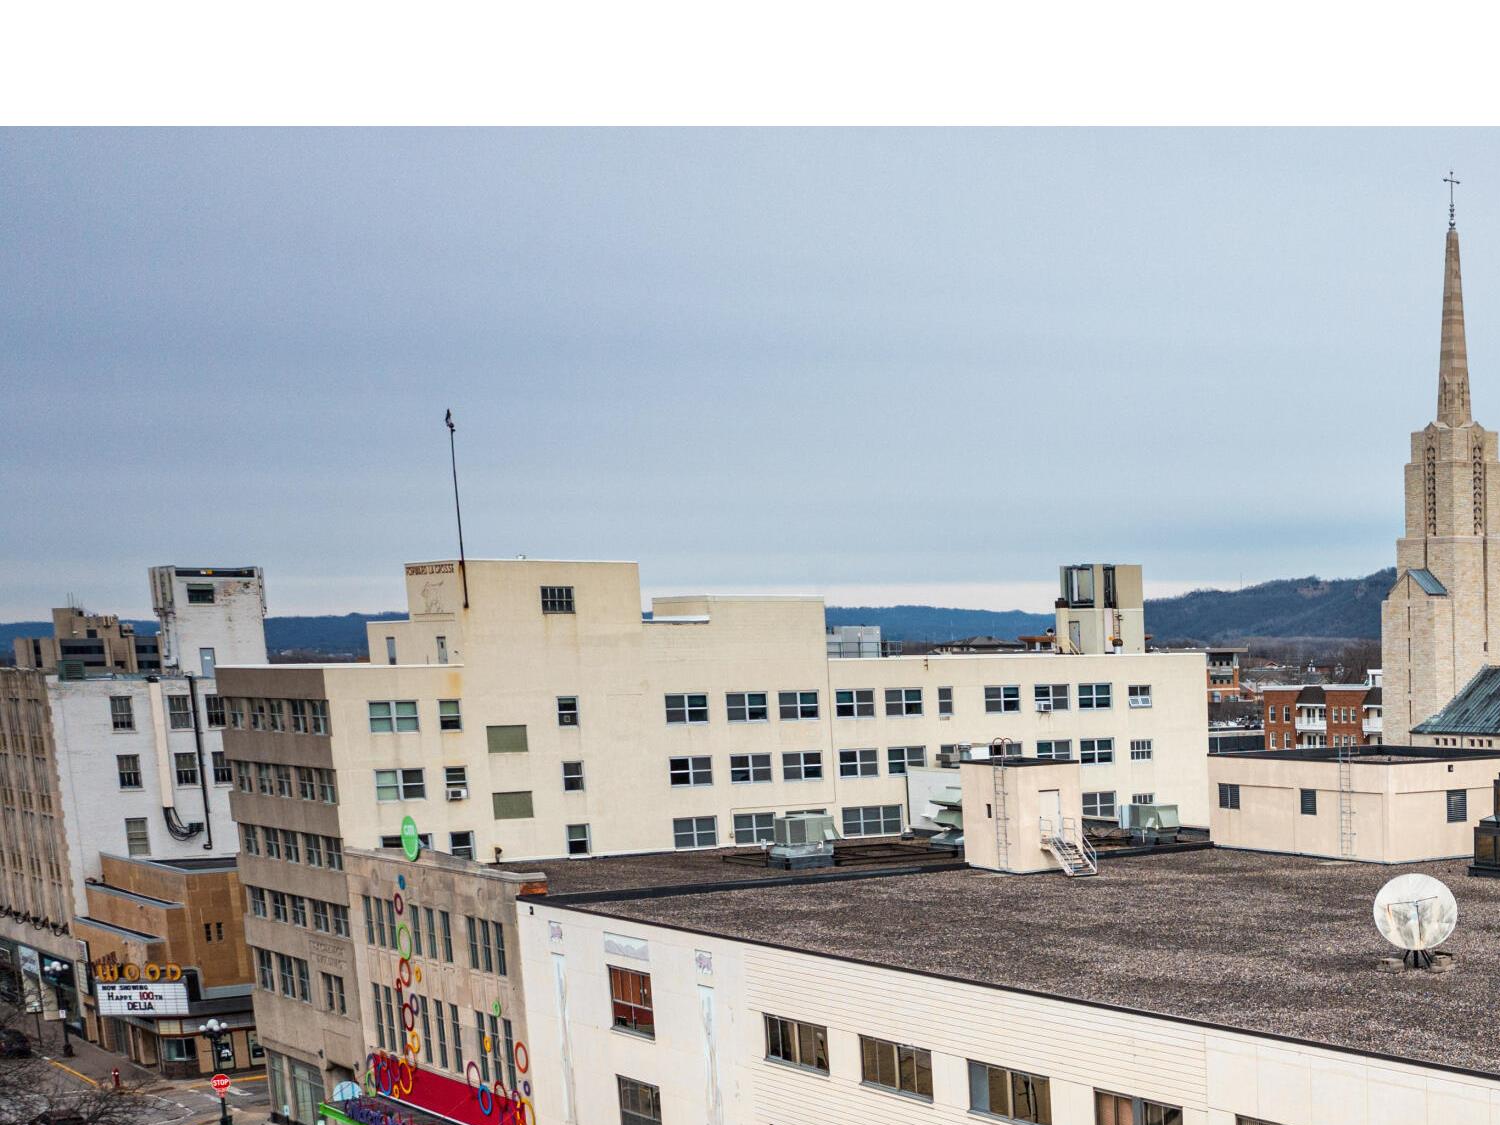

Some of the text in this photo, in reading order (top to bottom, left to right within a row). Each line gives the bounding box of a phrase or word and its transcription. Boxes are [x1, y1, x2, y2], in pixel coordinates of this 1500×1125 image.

[97, 962, 183, 982] WOOD
[127, 1001, 155, 1011] DELIA
[212, 1078, 229, 1087] STOP
